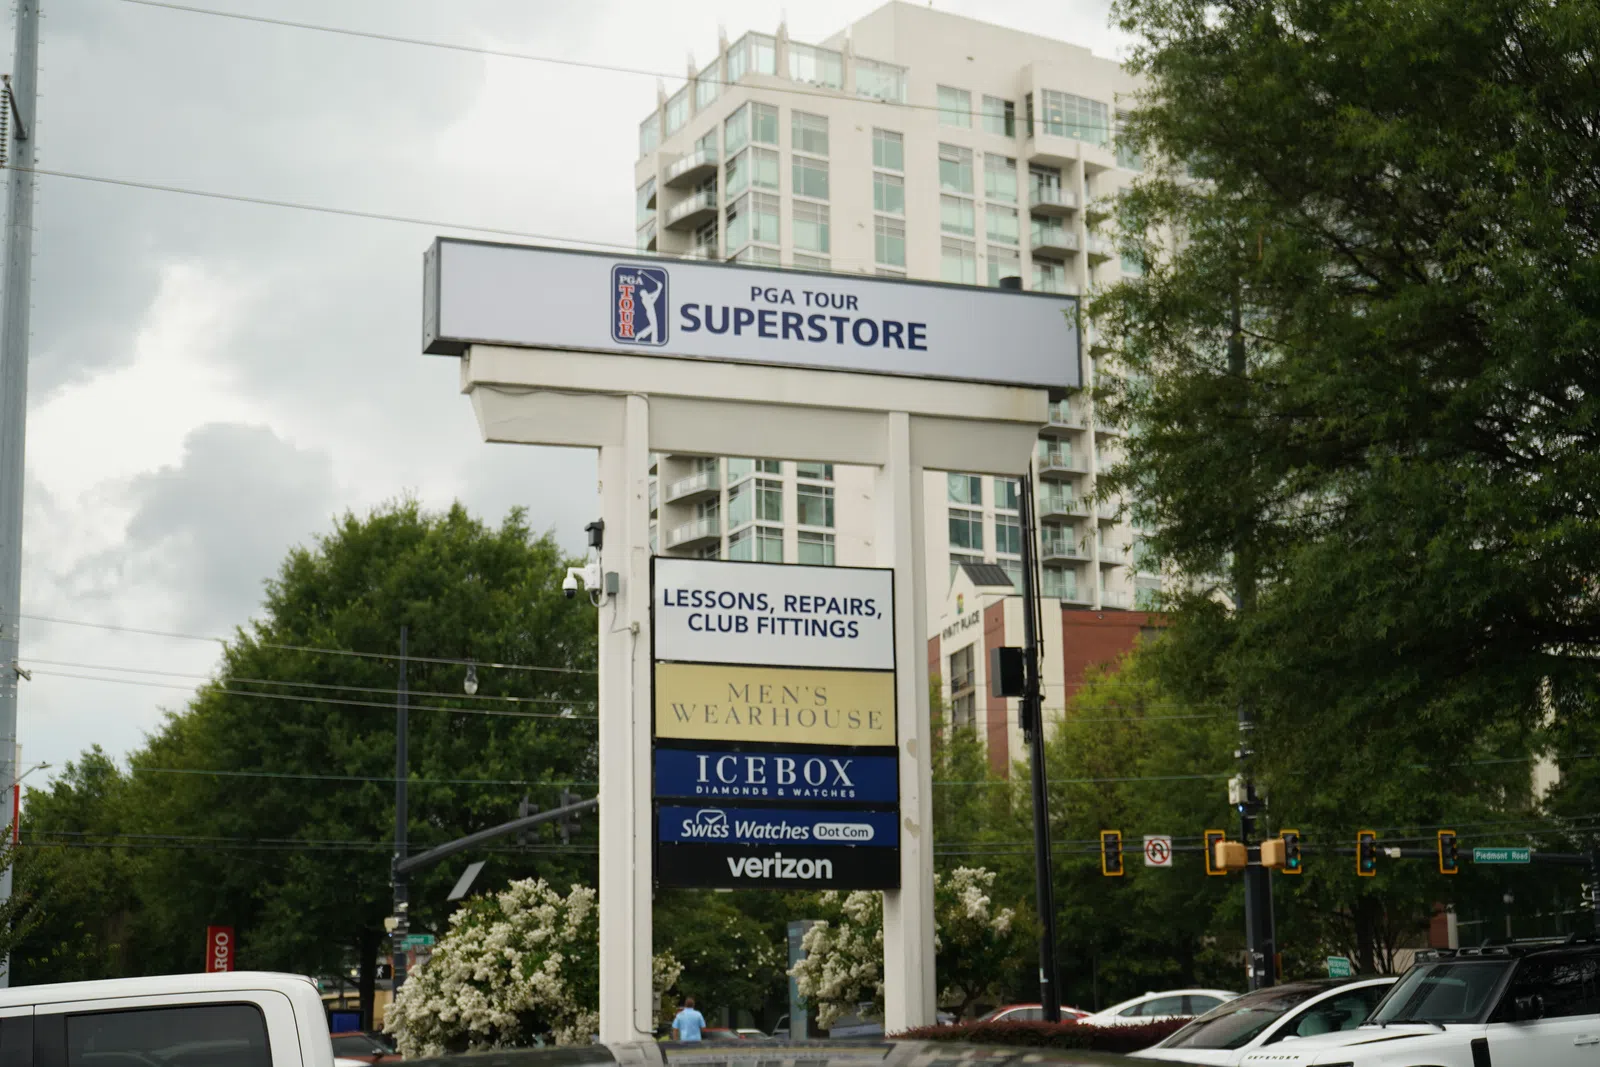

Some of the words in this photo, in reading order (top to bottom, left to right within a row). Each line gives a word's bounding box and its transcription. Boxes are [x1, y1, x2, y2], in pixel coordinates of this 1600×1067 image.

[619, 274, 644, 286] PGA
[618, 284, 635, 338] TOUR
[751, 286, 795, 305] PGA
[803, 291, 859, 311] TOUR
[680, 303, 928, 351] SUPERSTORE
[664, 588, 775, 614] LESSONS,
[784, 594, 883, 620] REPAIRS,
[688, 613, 749, 633] CLUB
[757, 616, 859, 639] FITTINGS
[728, 682, 828, 707] MEN'S
[671, 703, 883, 731] WEARHOUSE
[696, 755, 855, 787] ICEBOX
[696, 786, 769, 796] DIAMONDS
[777, 788, 785, 796] &
[793, 788, 856, 798] WATCHES
[681, 819, 729, 838] Swiss
[735, 821, 810, 840] Watches
[818, 826, 839, 837] Dot
[843, 827, 869, 838] Com
[727, 852, 832, 879] verizon
[1475, 851, 1508, 860] Piedmont
[1511, 851, 1528, 860] Road
